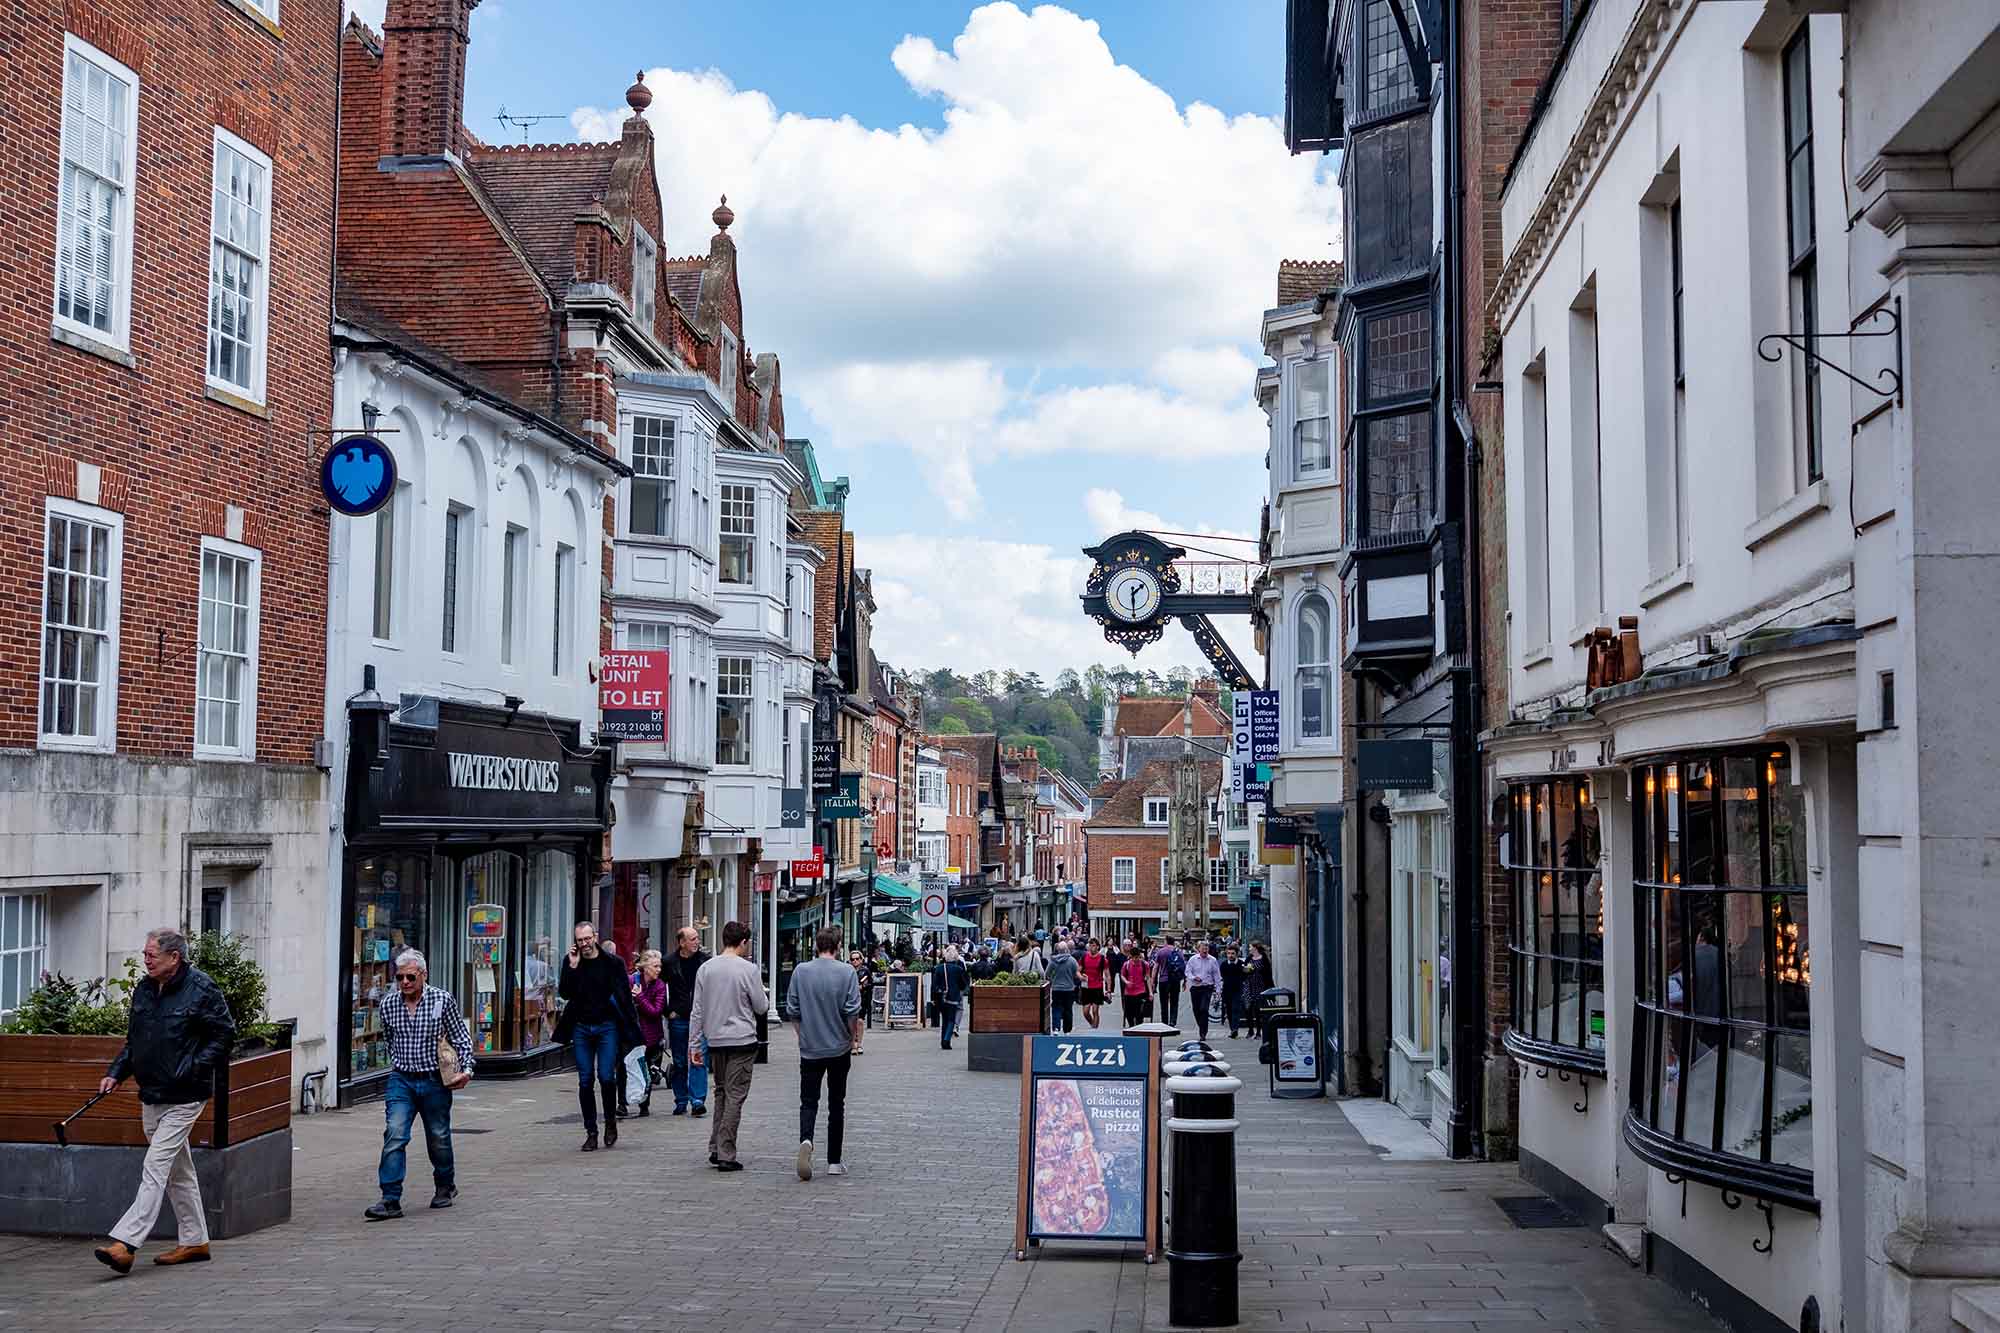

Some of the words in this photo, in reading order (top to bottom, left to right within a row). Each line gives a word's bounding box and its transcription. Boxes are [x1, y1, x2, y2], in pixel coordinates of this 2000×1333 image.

[602, 655, 651, 668] RETAIL
[603, 670, 640, 682] UNIT
[603, 690, 626, 705] TO
[633, 690, 663, 705] LET
[1254, 697, 1270, 706] TO
[1236, 699, 1249, 727] LET
[629, 722, 661, 731] 210810
[1236, 733, 1249, 754] TO
[448, 752, 559, 793] WATERSTONES
[1233, 779, 1241, 793] TO
[824, 799, 858, 808] ITALIAN
[795, 863, 820, 872] TECH
[925, 883, 945, 891] ZONE
[1055, 1043, 1126, 1067] Zizzi
[1095, 1086, 1141, 1095] 18-inches
[1087, 1096, 1096, 1105] of
[1098, 1096, 1141, 1105] delicious
[1091, 1107, 1140, 1119] Rustica
[1104, 1121, 1140, 1134] pizza
